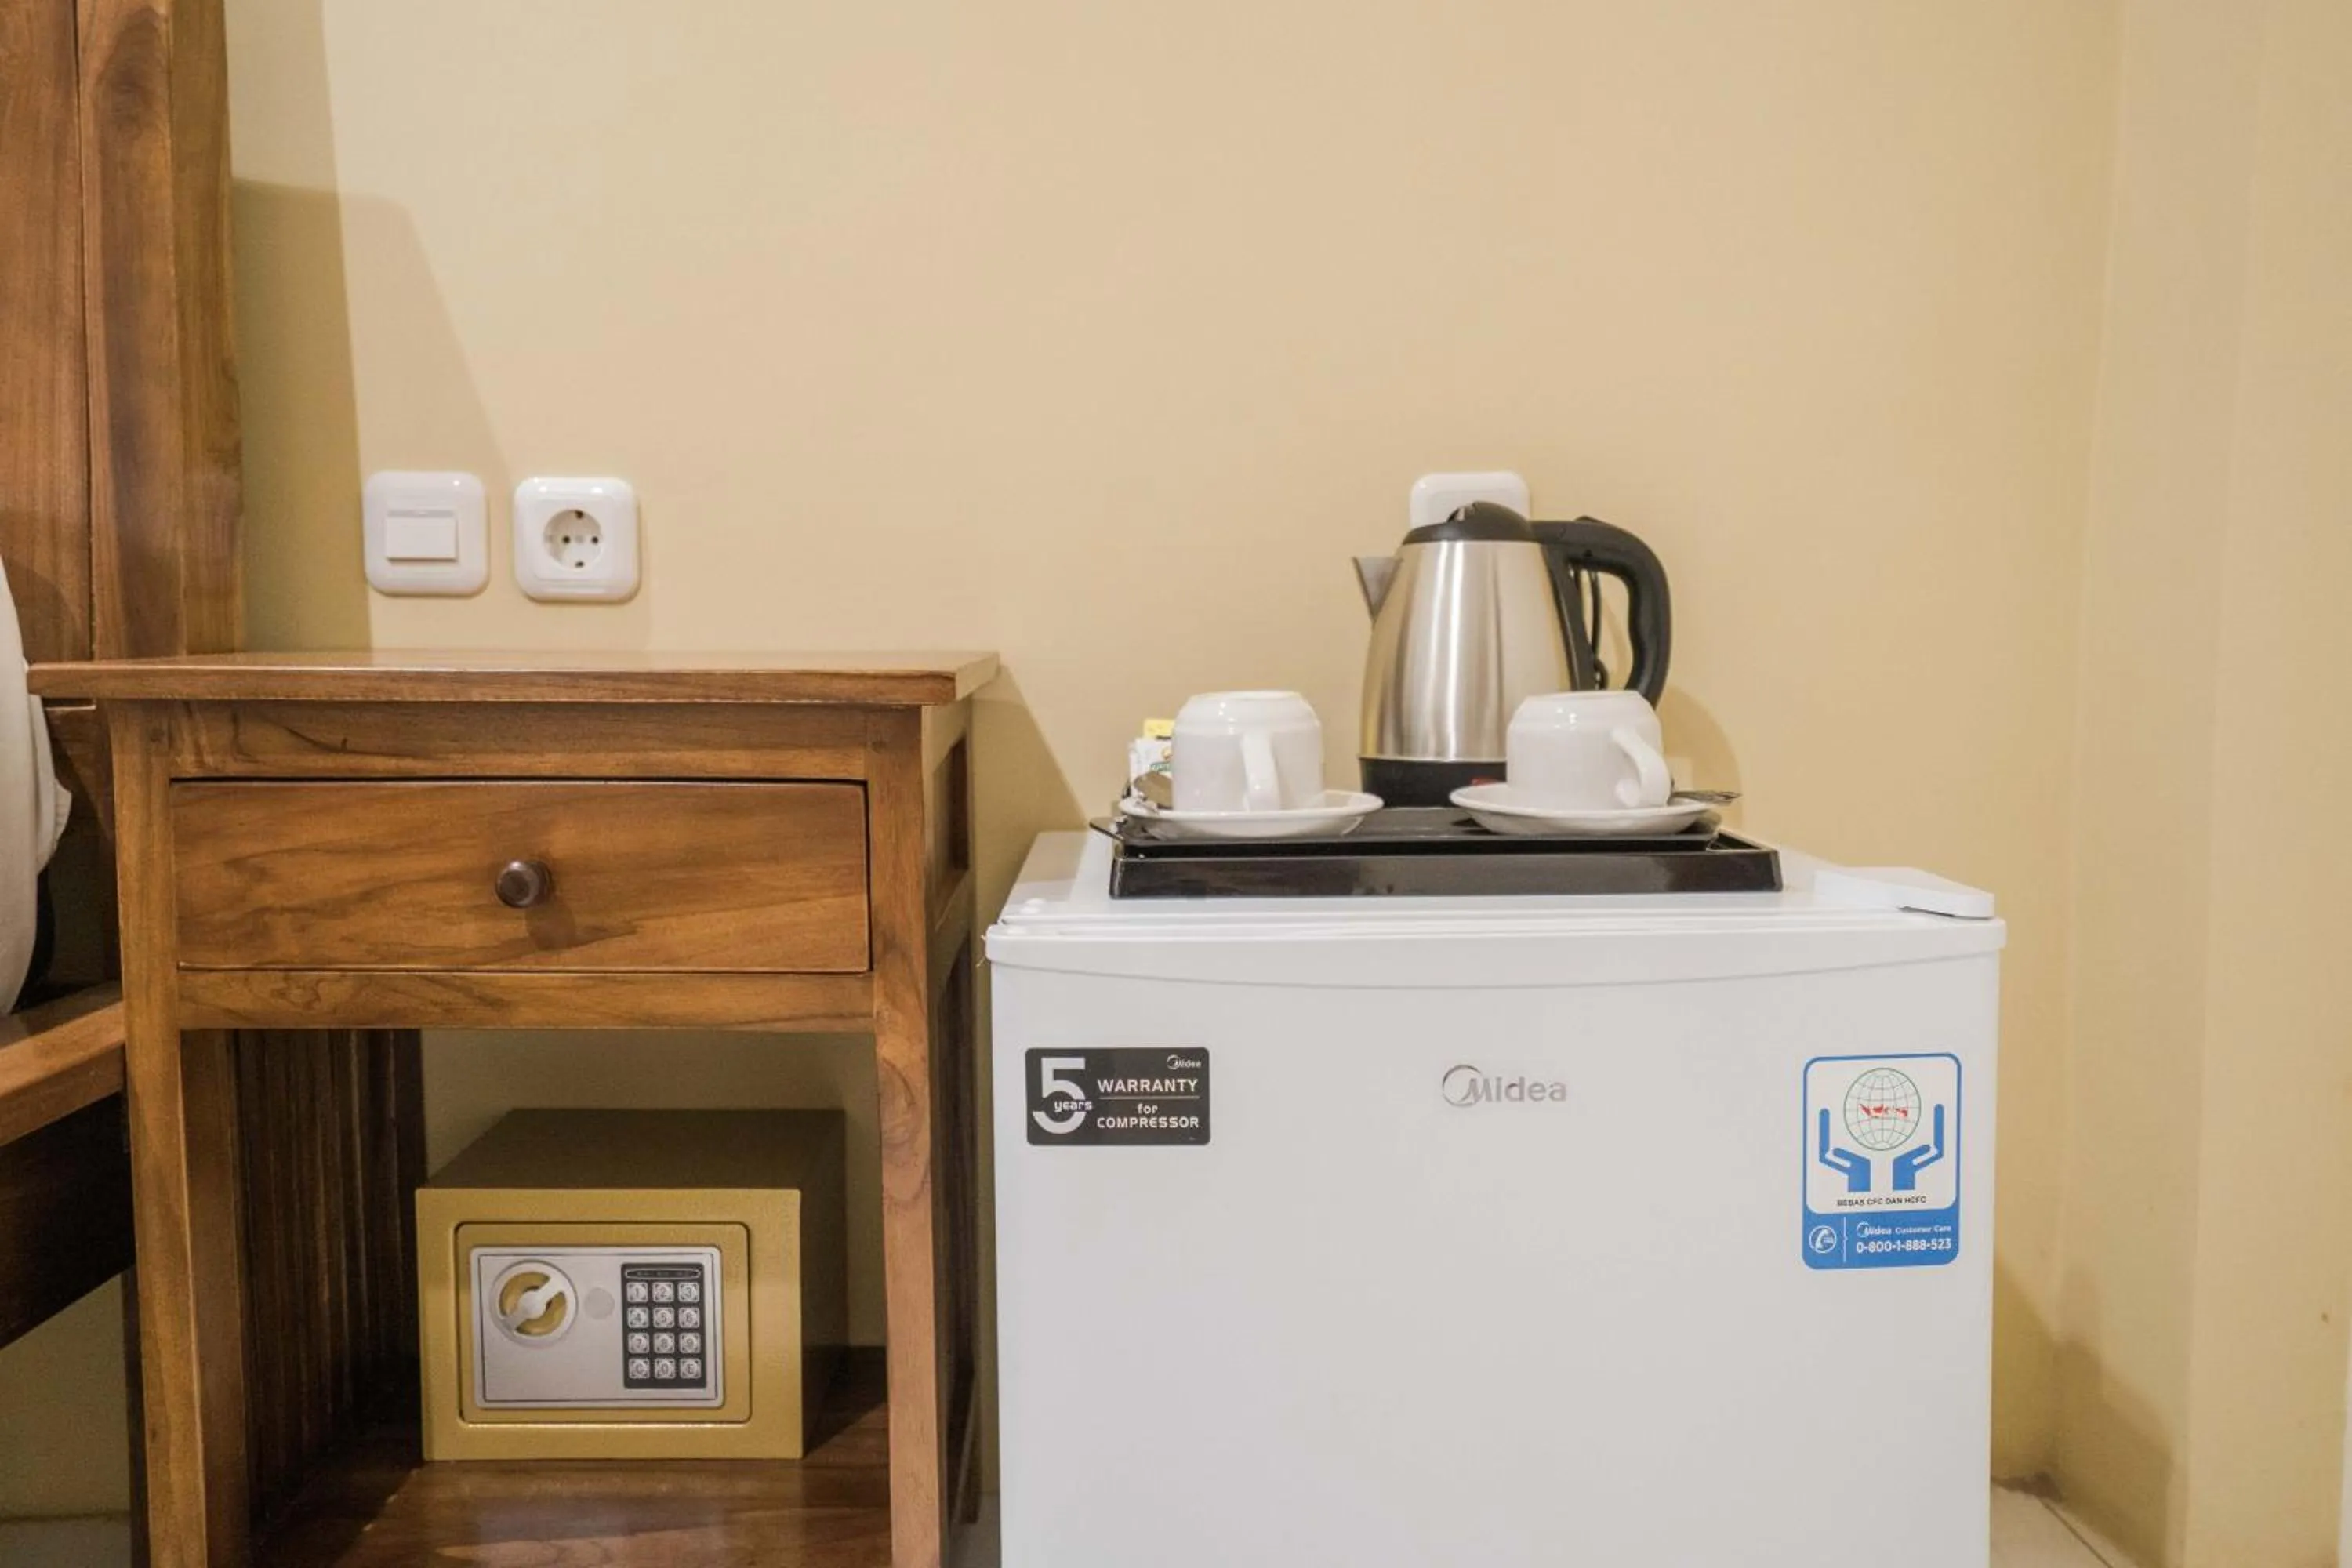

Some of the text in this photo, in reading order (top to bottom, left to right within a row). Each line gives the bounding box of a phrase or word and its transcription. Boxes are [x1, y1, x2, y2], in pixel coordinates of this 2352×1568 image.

[1166, 1054, 1202, 1070] Midea
[1097, 1078, 1198, 1093] WARRANTY
[1442, 1064, 1566, 1106] Midea
[1032, 1056, 1086, 1134] 5
[1054, 1099, 1092, 1112] years
[1137, 1103, 1158, 1114] for
[1097, 1116, 1199, 1128] COMPRESSOR
[1857, 1221, 1892, 1238] Midea
